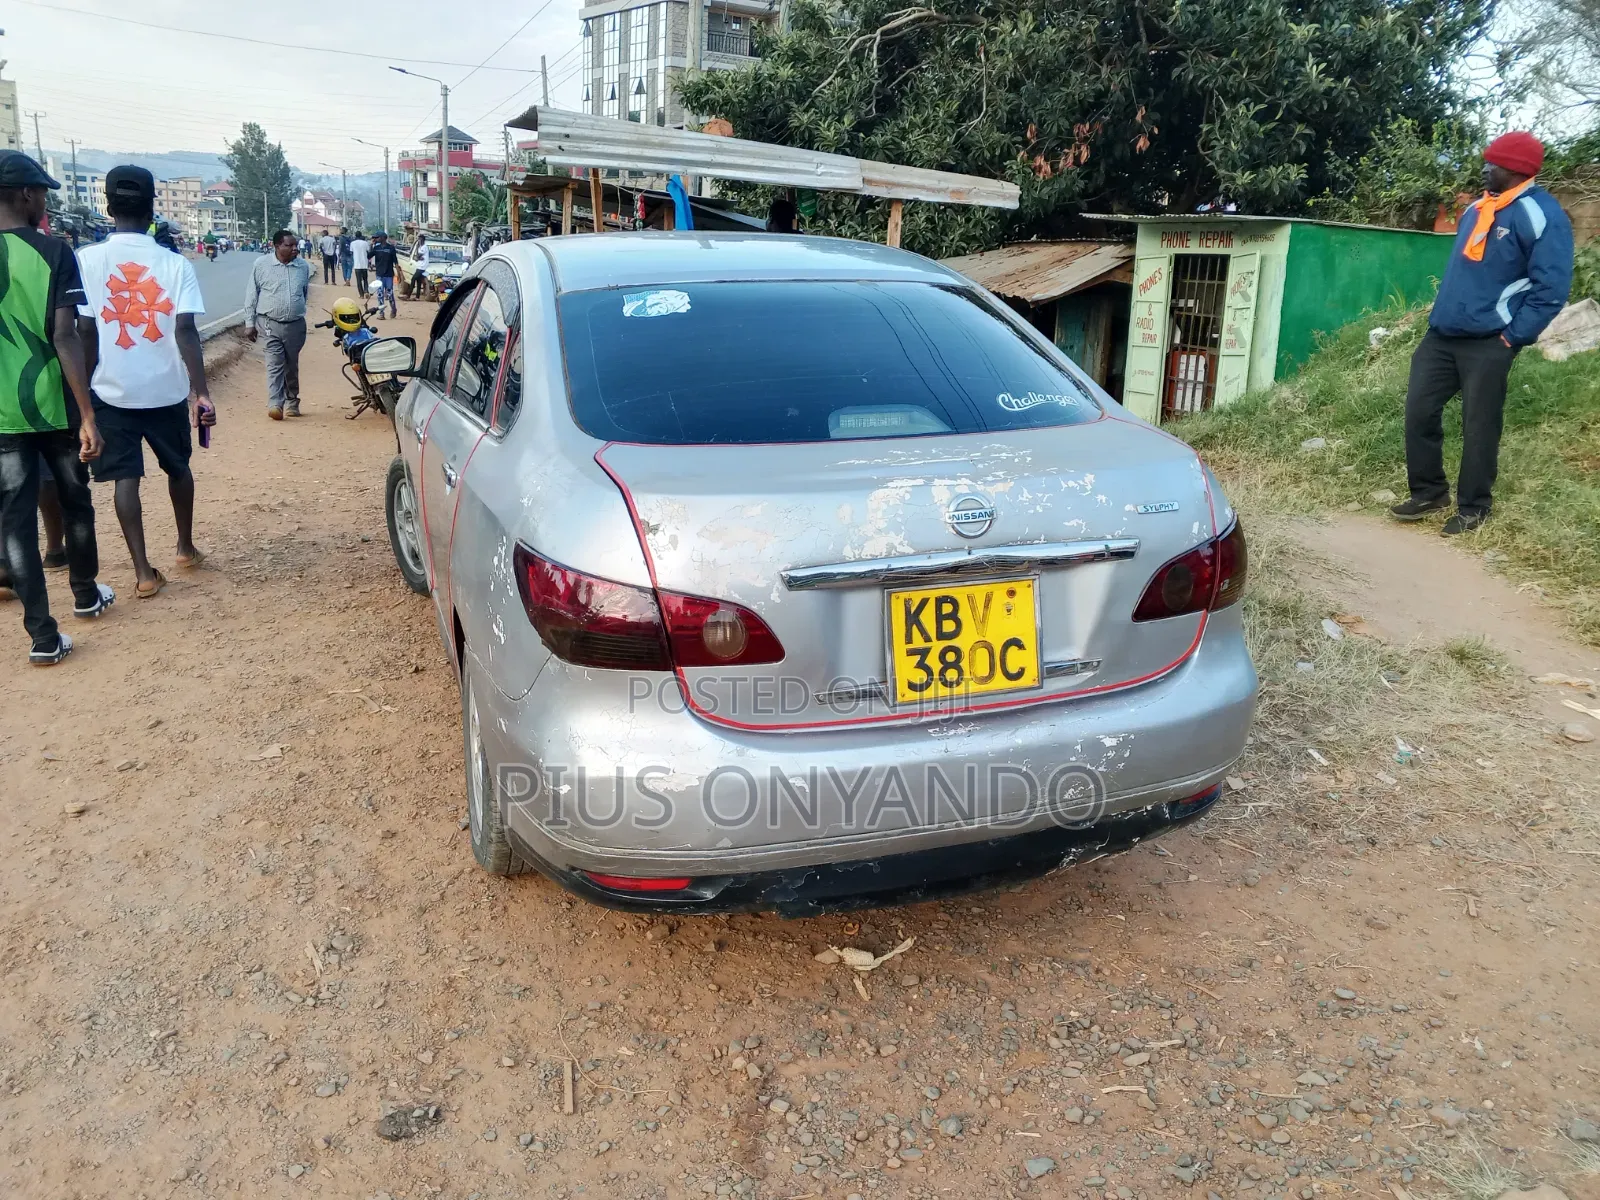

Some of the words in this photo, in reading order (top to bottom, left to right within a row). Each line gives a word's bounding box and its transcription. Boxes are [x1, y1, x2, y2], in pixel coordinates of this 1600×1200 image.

[1160, 230, 1192, 249] PHONE
[1198, 230, 1235, 249] REPAIR
[1136, 317, 1154, 331] RADIO
[997, 391, 1079, 411] Challenger
[951, 509, 995, 522] NISSAN
[1143, 502, 1175, 513] SYLPHY
[903, 591, 994, 645] KBV
[905, 637, 1027, 692] 380C
